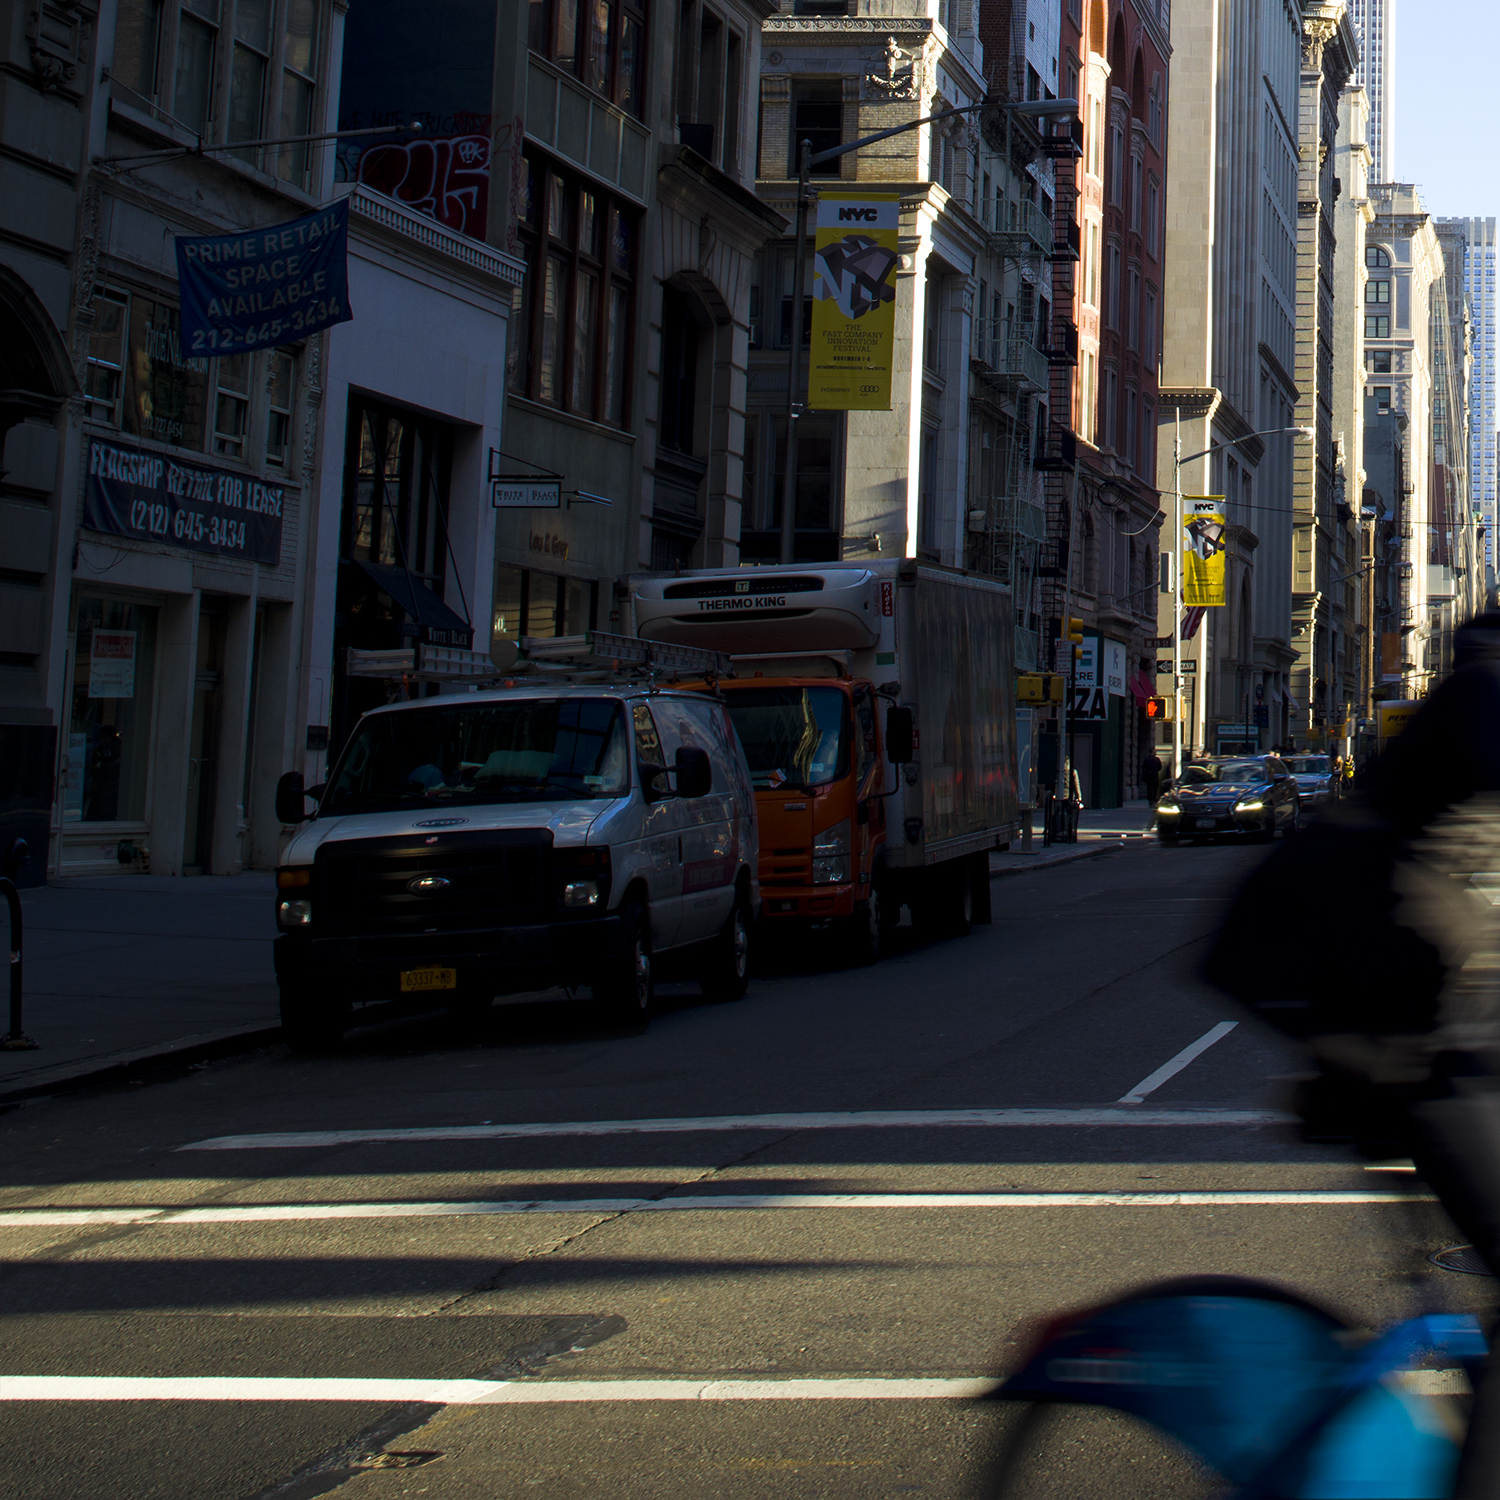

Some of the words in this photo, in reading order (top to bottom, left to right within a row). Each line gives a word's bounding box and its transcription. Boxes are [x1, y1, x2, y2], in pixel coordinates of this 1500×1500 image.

[838, 207, 878, 222] NYC
[184, 238, 256, 263] PRIME
[264, 214, 340, 253] RETAIL
[225, 255, 301, 289] SPACE
[207, 270, 326, 317] AVAILABLE
[192, 296, 340, 350] 212-645-3434
[827, 338, 878, 346] INNOVATION
[844, 331, 884, 339] COMPANY
[833, 345, 872, 353] FESTIVAL
[91, 442, 163, 490] FLAGSHIP
[167, 462, 214, 501] RETAIL
[217, 475, 242, 508] FOR
[246, 482, 283, 517] LEASE
[496, 490, 524, 498] WHITE
[532, 490, 558, 498] BLACK
[1194, 503, 1214, 511] NYC
[131, 499, 170, 535] (212)
[175, 509, 246, 550] 645-3434
[698, 598, 753, 610] THERMO
[755, 596, 786, 608] KING
[883, 583, 892, 615] Kidron
[451, 629, 468, 646] BLACK
